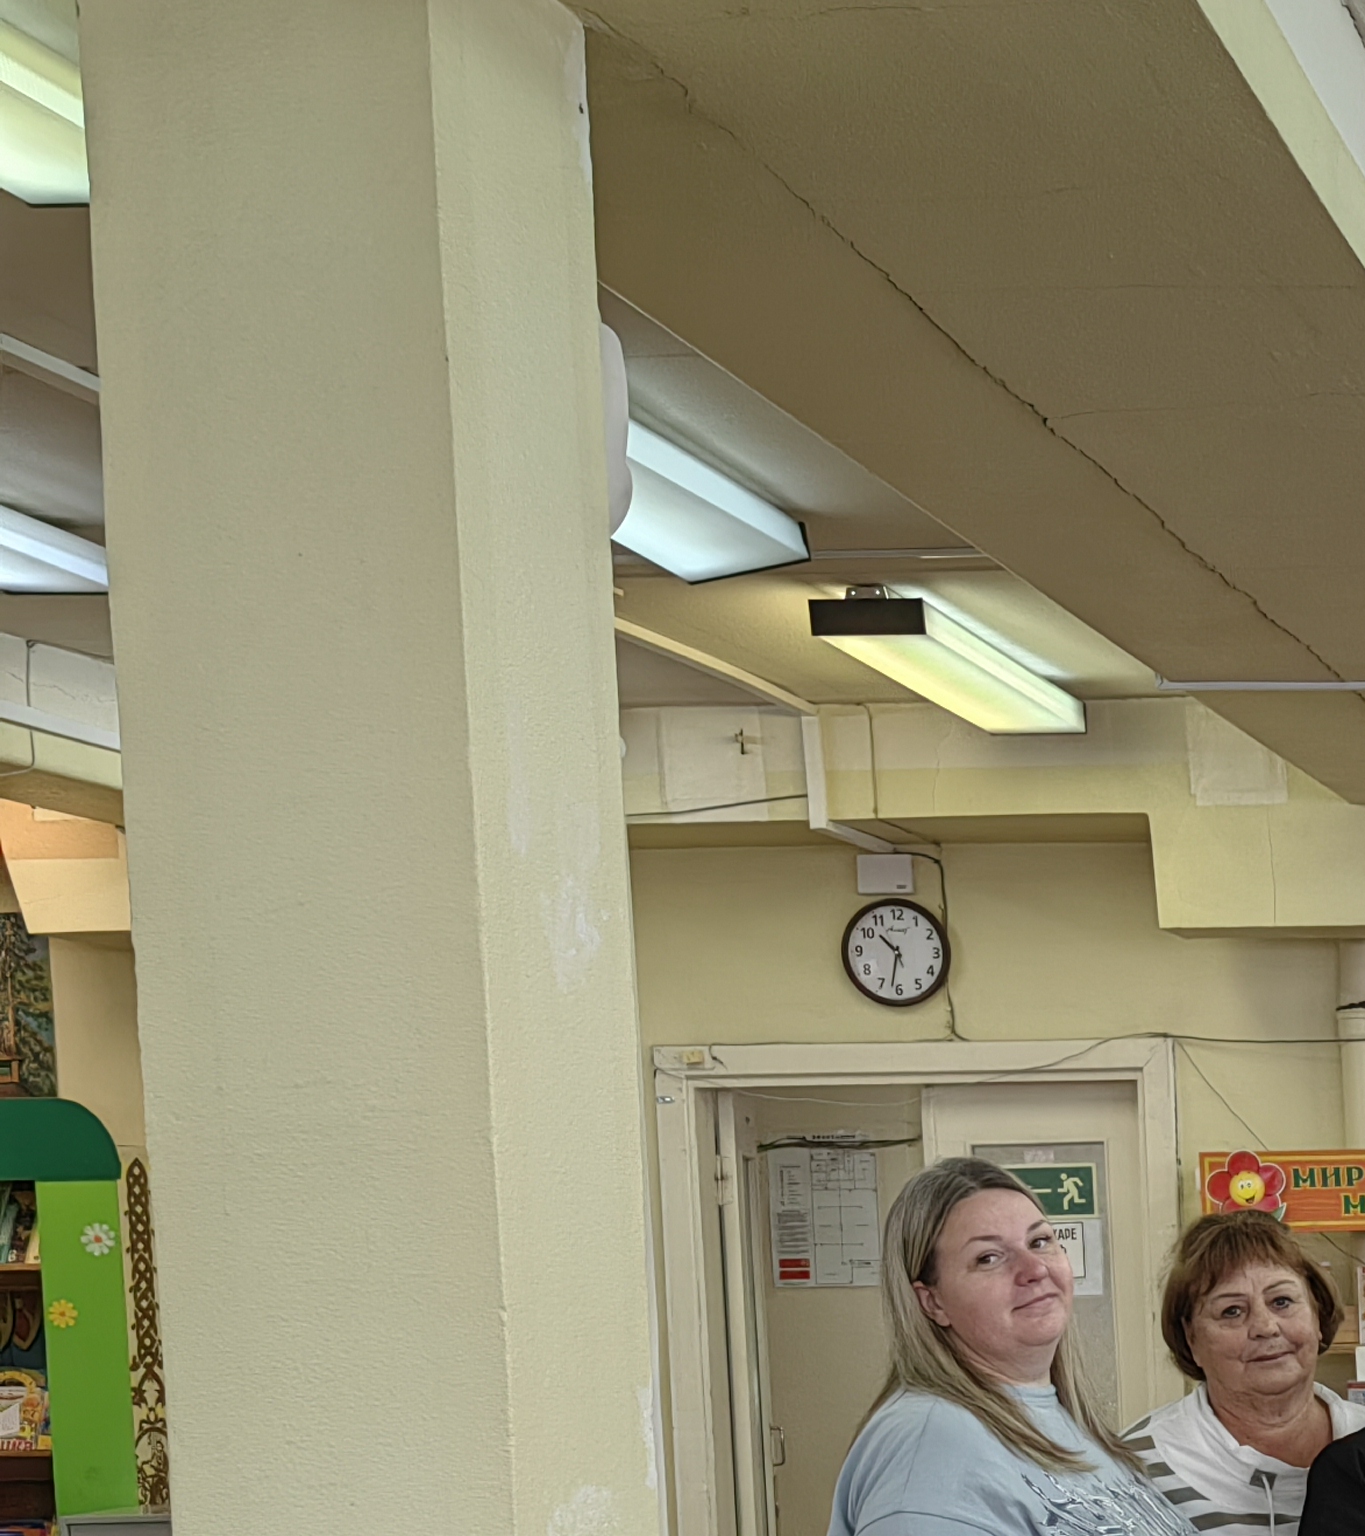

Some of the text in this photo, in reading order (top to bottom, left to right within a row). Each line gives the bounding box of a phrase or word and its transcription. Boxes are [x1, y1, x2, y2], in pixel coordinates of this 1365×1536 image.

[872, 914, 884, 927] 11
[889, 908, 905, 921] 12
[912, 915, 919, 927] 1
[860, 927, 875, 939] 10
[926, 928, 934, 940] 2
[855, 945, 863, 957] 9
[932, 947, 941, 959] 3
[863, 963, 871, 976] 8
[926, 965, 935, 977] 4
[877, 977, 886, 990] 7
[914, 978, 923, 990] 5
[895, 984, 904, 996] 6
[1291, 1164, 1364, 1188] МИР
